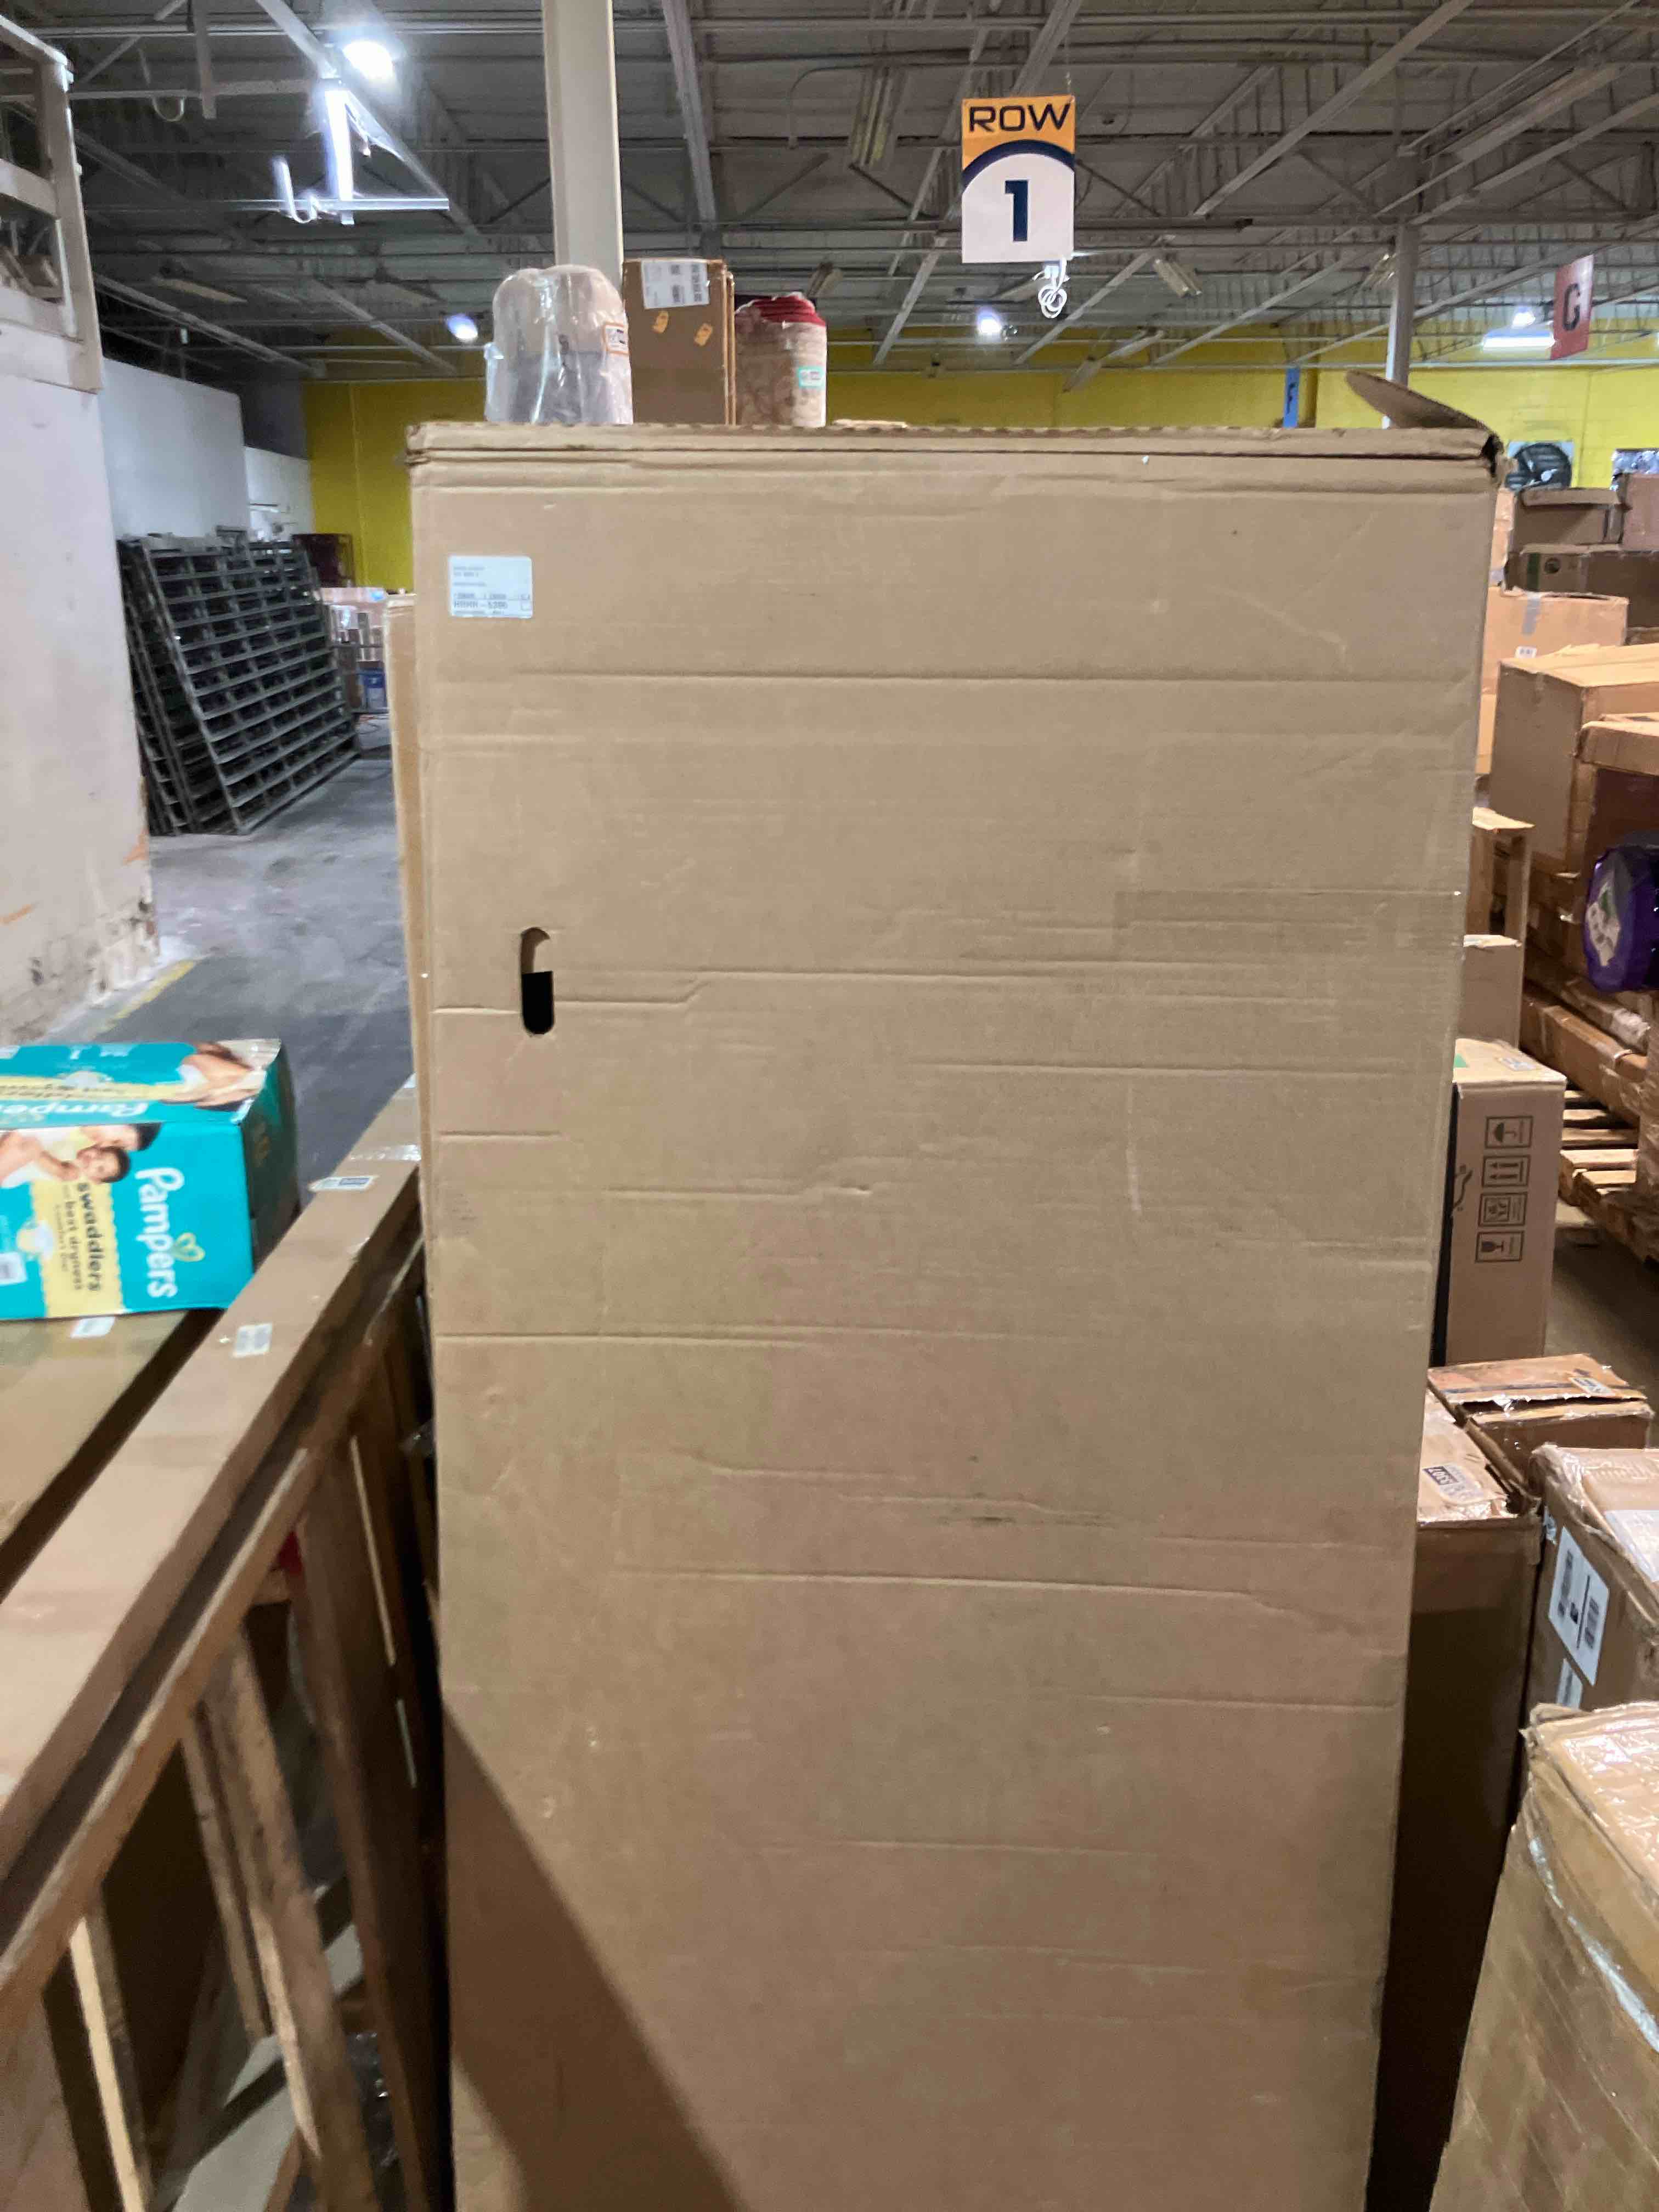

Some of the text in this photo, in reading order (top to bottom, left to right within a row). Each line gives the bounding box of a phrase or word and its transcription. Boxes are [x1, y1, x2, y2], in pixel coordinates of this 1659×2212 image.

[969, 103, 1071, 132] ROW
[1005, 179, 1029, 242] 1
[1562, 283, 1581, 330] G
[77, 1182, 105, 1291] swaddlers
[134, 1167, 185, 1298] Pampers
